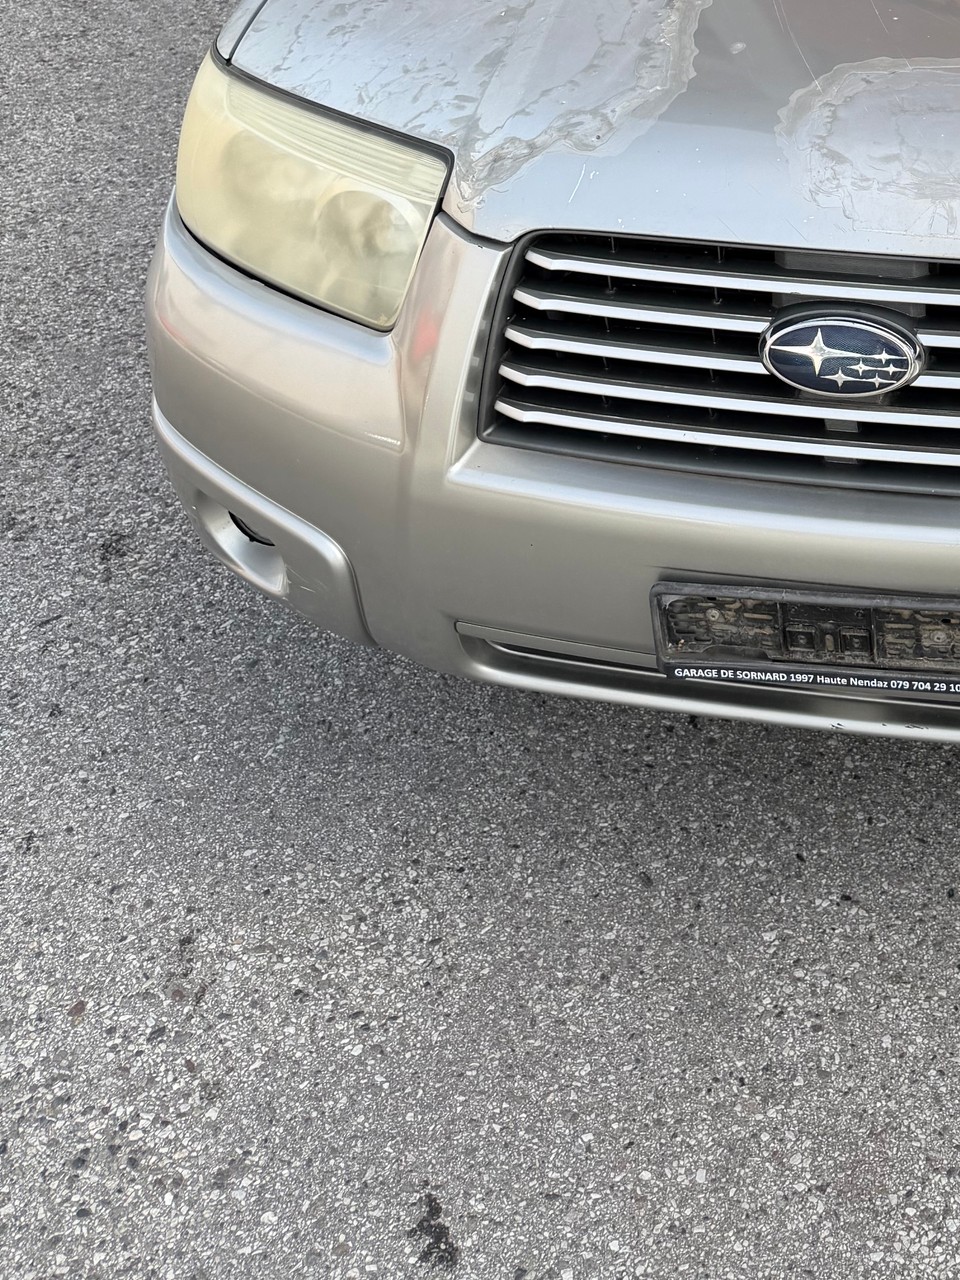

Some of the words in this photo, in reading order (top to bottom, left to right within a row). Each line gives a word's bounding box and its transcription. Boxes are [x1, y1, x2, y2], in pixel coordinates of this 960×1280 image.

[674, 667, 719, 679] GARAGE
[720, 669, 735, 679] DE
[736, 670, 788, 681] SORNARD
[789, 673, 814, 683] 1997
[816, 675, 848, 686] Haute
[849, 677, 888, 689] Nendaz
[890, 680, 910, 690] 079
[911, 681, 932, 691] 704
[933, 682, 947, 692] 29
